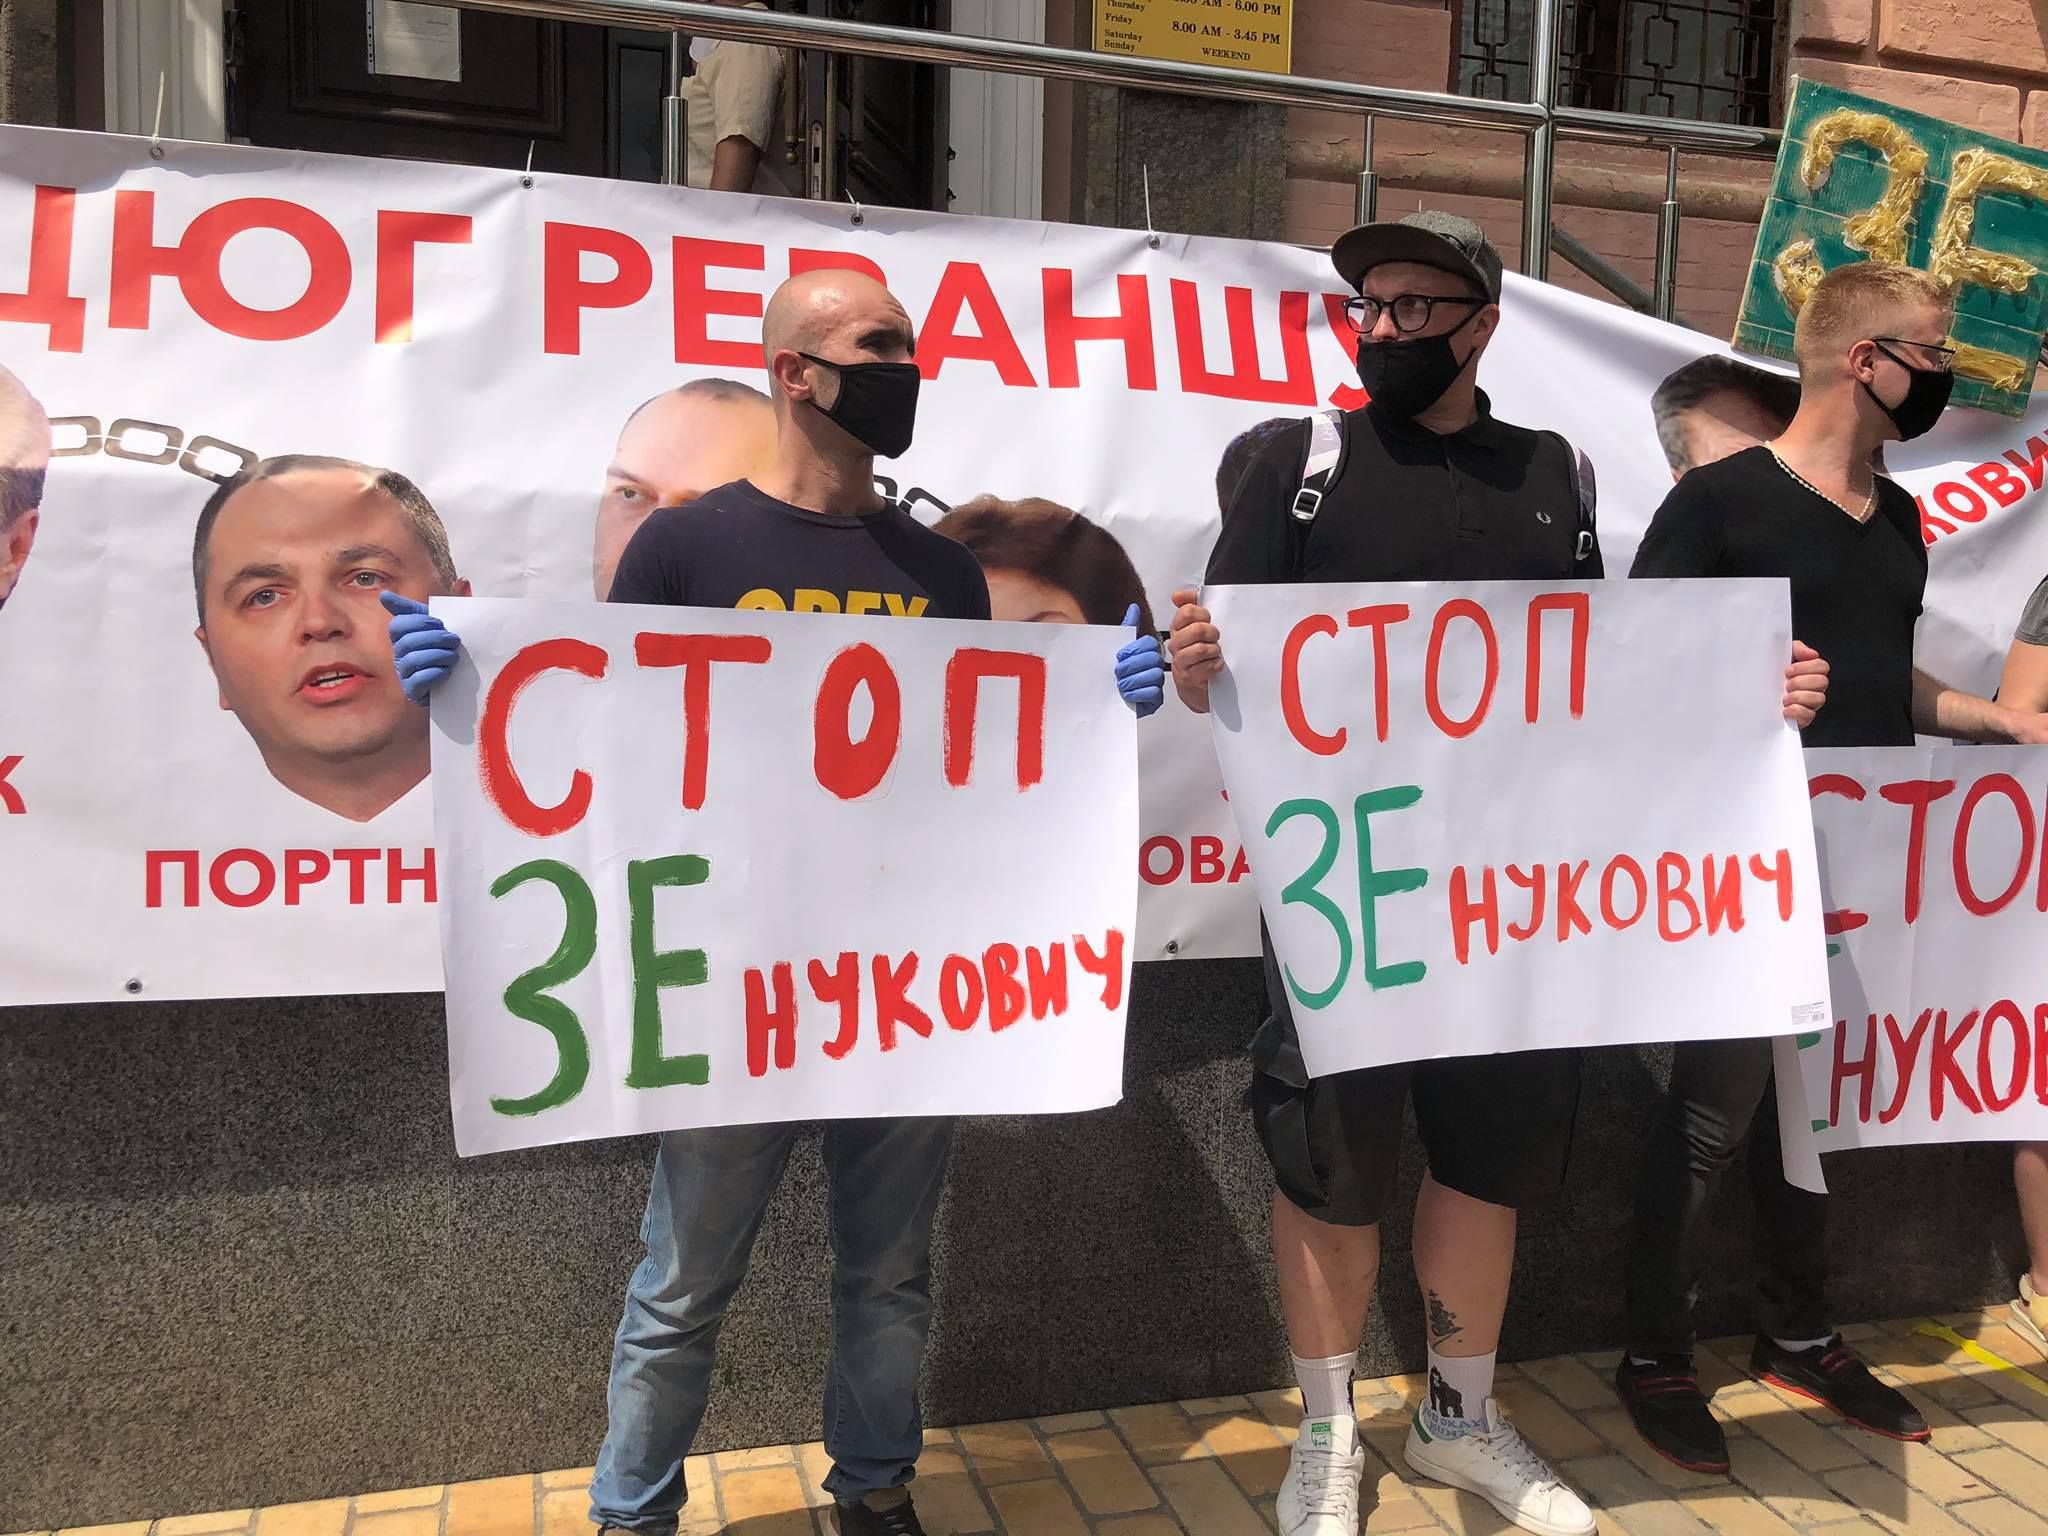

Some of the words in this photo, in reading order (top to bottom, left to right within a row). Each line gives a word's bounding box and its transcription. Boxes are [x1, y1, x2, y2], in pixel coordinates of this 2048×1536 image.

[1107, 0, 1145, 12] Thursday
[1234, 2, 1259, 12] 6.00
[1263, 4, 1281, 15] PM
[1104, 29, 1143, 42] Saturday
[1105, 13, 1133, 24] Friday
[1172, 21, 1197, 34] 8.00
[1201, 25, 1221, 37] AM
[1234, 29, 1257, 42] 3.45
[1262, 33, 1280, 44] PM
[1104, 40, 1136, 52] Sunday
[1202, 47, 1251, 61] WEEKEND
[1914, 429, 2048, 545] КОВИ
[1280, 592, 1590, 756] СТОП
[478, 632, 1047, 838] СТОП
[146, 847, 438, 908] ПОРТН
